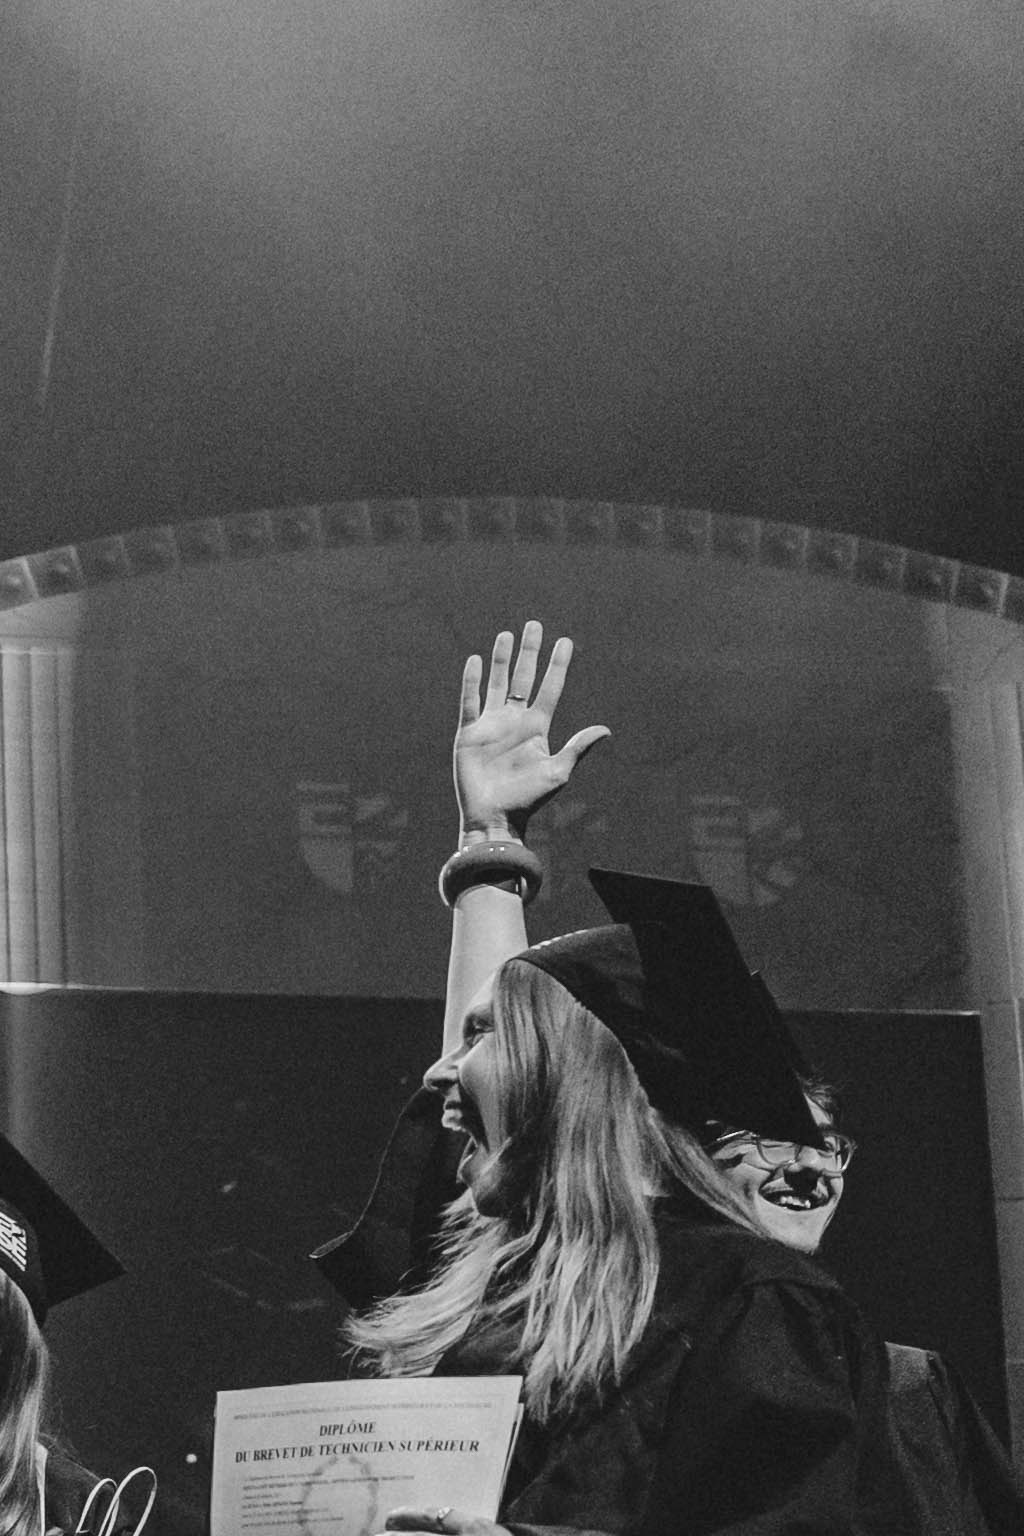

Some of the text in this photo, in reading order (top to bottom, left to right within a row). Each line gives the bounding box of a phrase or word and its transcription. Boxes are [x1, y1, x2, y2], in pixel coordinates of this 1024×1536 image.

[319, 1419, 376, 1437] DIPLÔME
[235, 1450, 250, 1463] DU
[253, 1447, 297, 1461] BREVET
[300, 1445, 315, 1458] DE
[318, 1440, 395, 1456] TECHNICIEN
